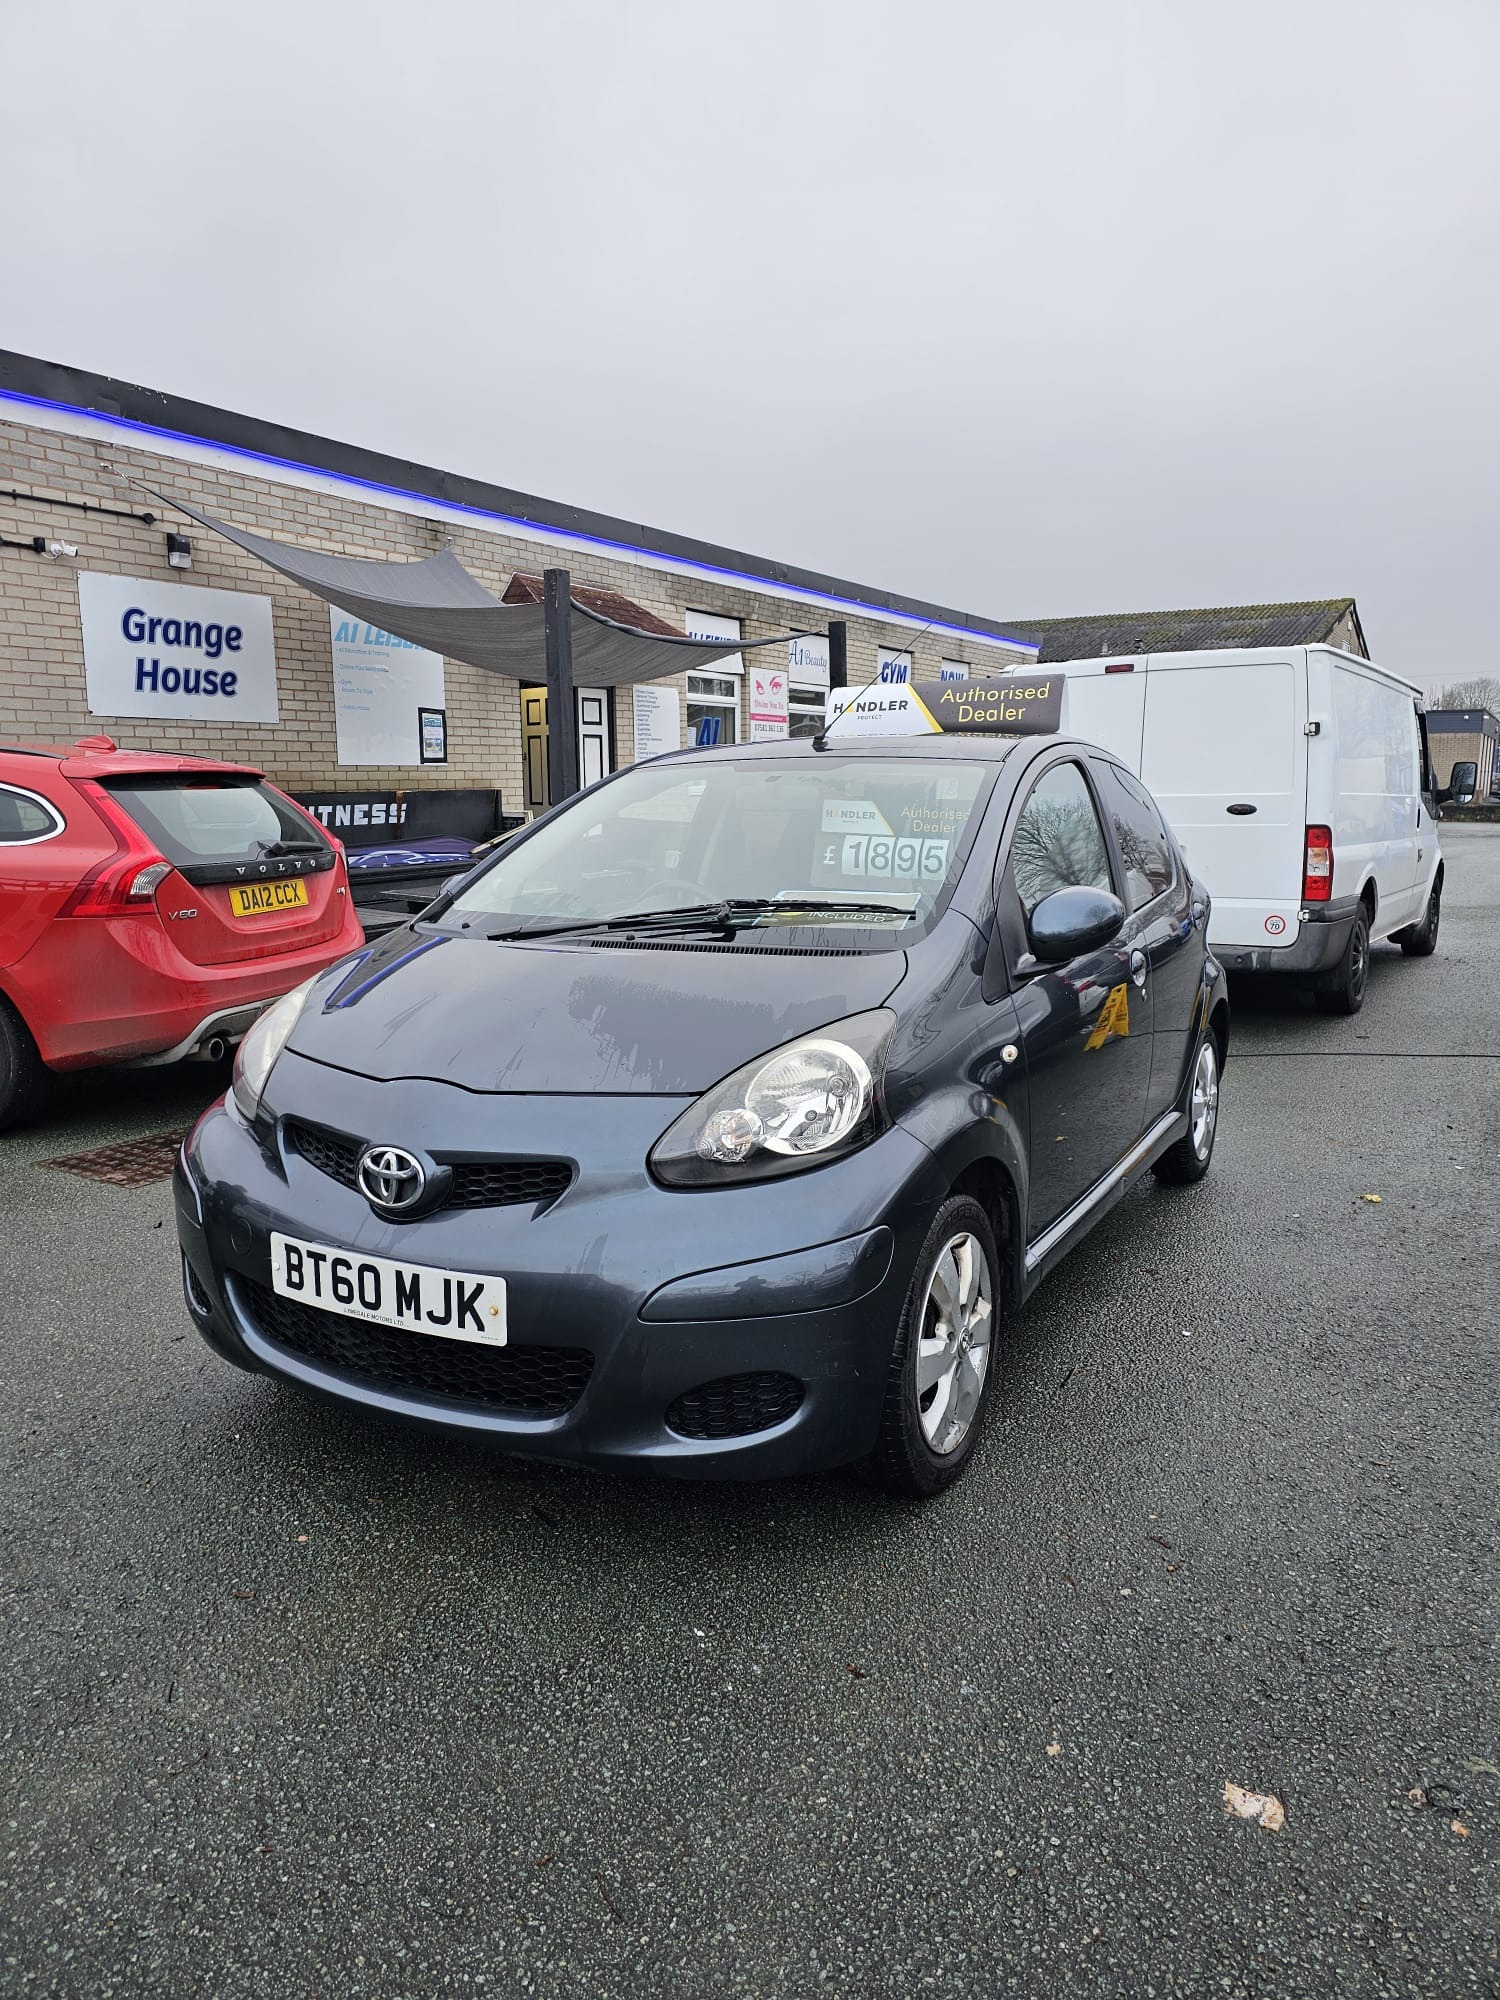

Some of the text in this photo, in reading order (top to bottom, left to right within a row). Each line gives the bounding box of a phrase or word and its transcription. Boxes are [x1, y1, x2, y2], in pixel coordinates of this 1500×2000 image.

[120, 607, 244, 659] Grange
[363, 625, 426, 650] LEIS
[804, 650, 828, 672] Beauty
[133, 657, 239, 697] House
[881, 661, 908, 684] GYM
[940, 682, 1051, 704] Authorised
[958, 703, 1027, 723] Dealer
[302, 803, 407, 827] TNESS
[901, 807, 971, 821] Authorised
[913, 820, 957, 833] Dealer
[235, 858, 317, 875] VOLVO
[239, 882, 301, 911] DA12 CCX
[168, 908, 198, 921] V60
[809, 911, 886, 923] INCLUDED
[1270, 922, 1280, 930] 70
[284, 1243, 486, 1332] BT60 MJK
[344, 1307, 371, 1319] LYMEDALE
[371, 1314, 393, 1324] MOTORS
